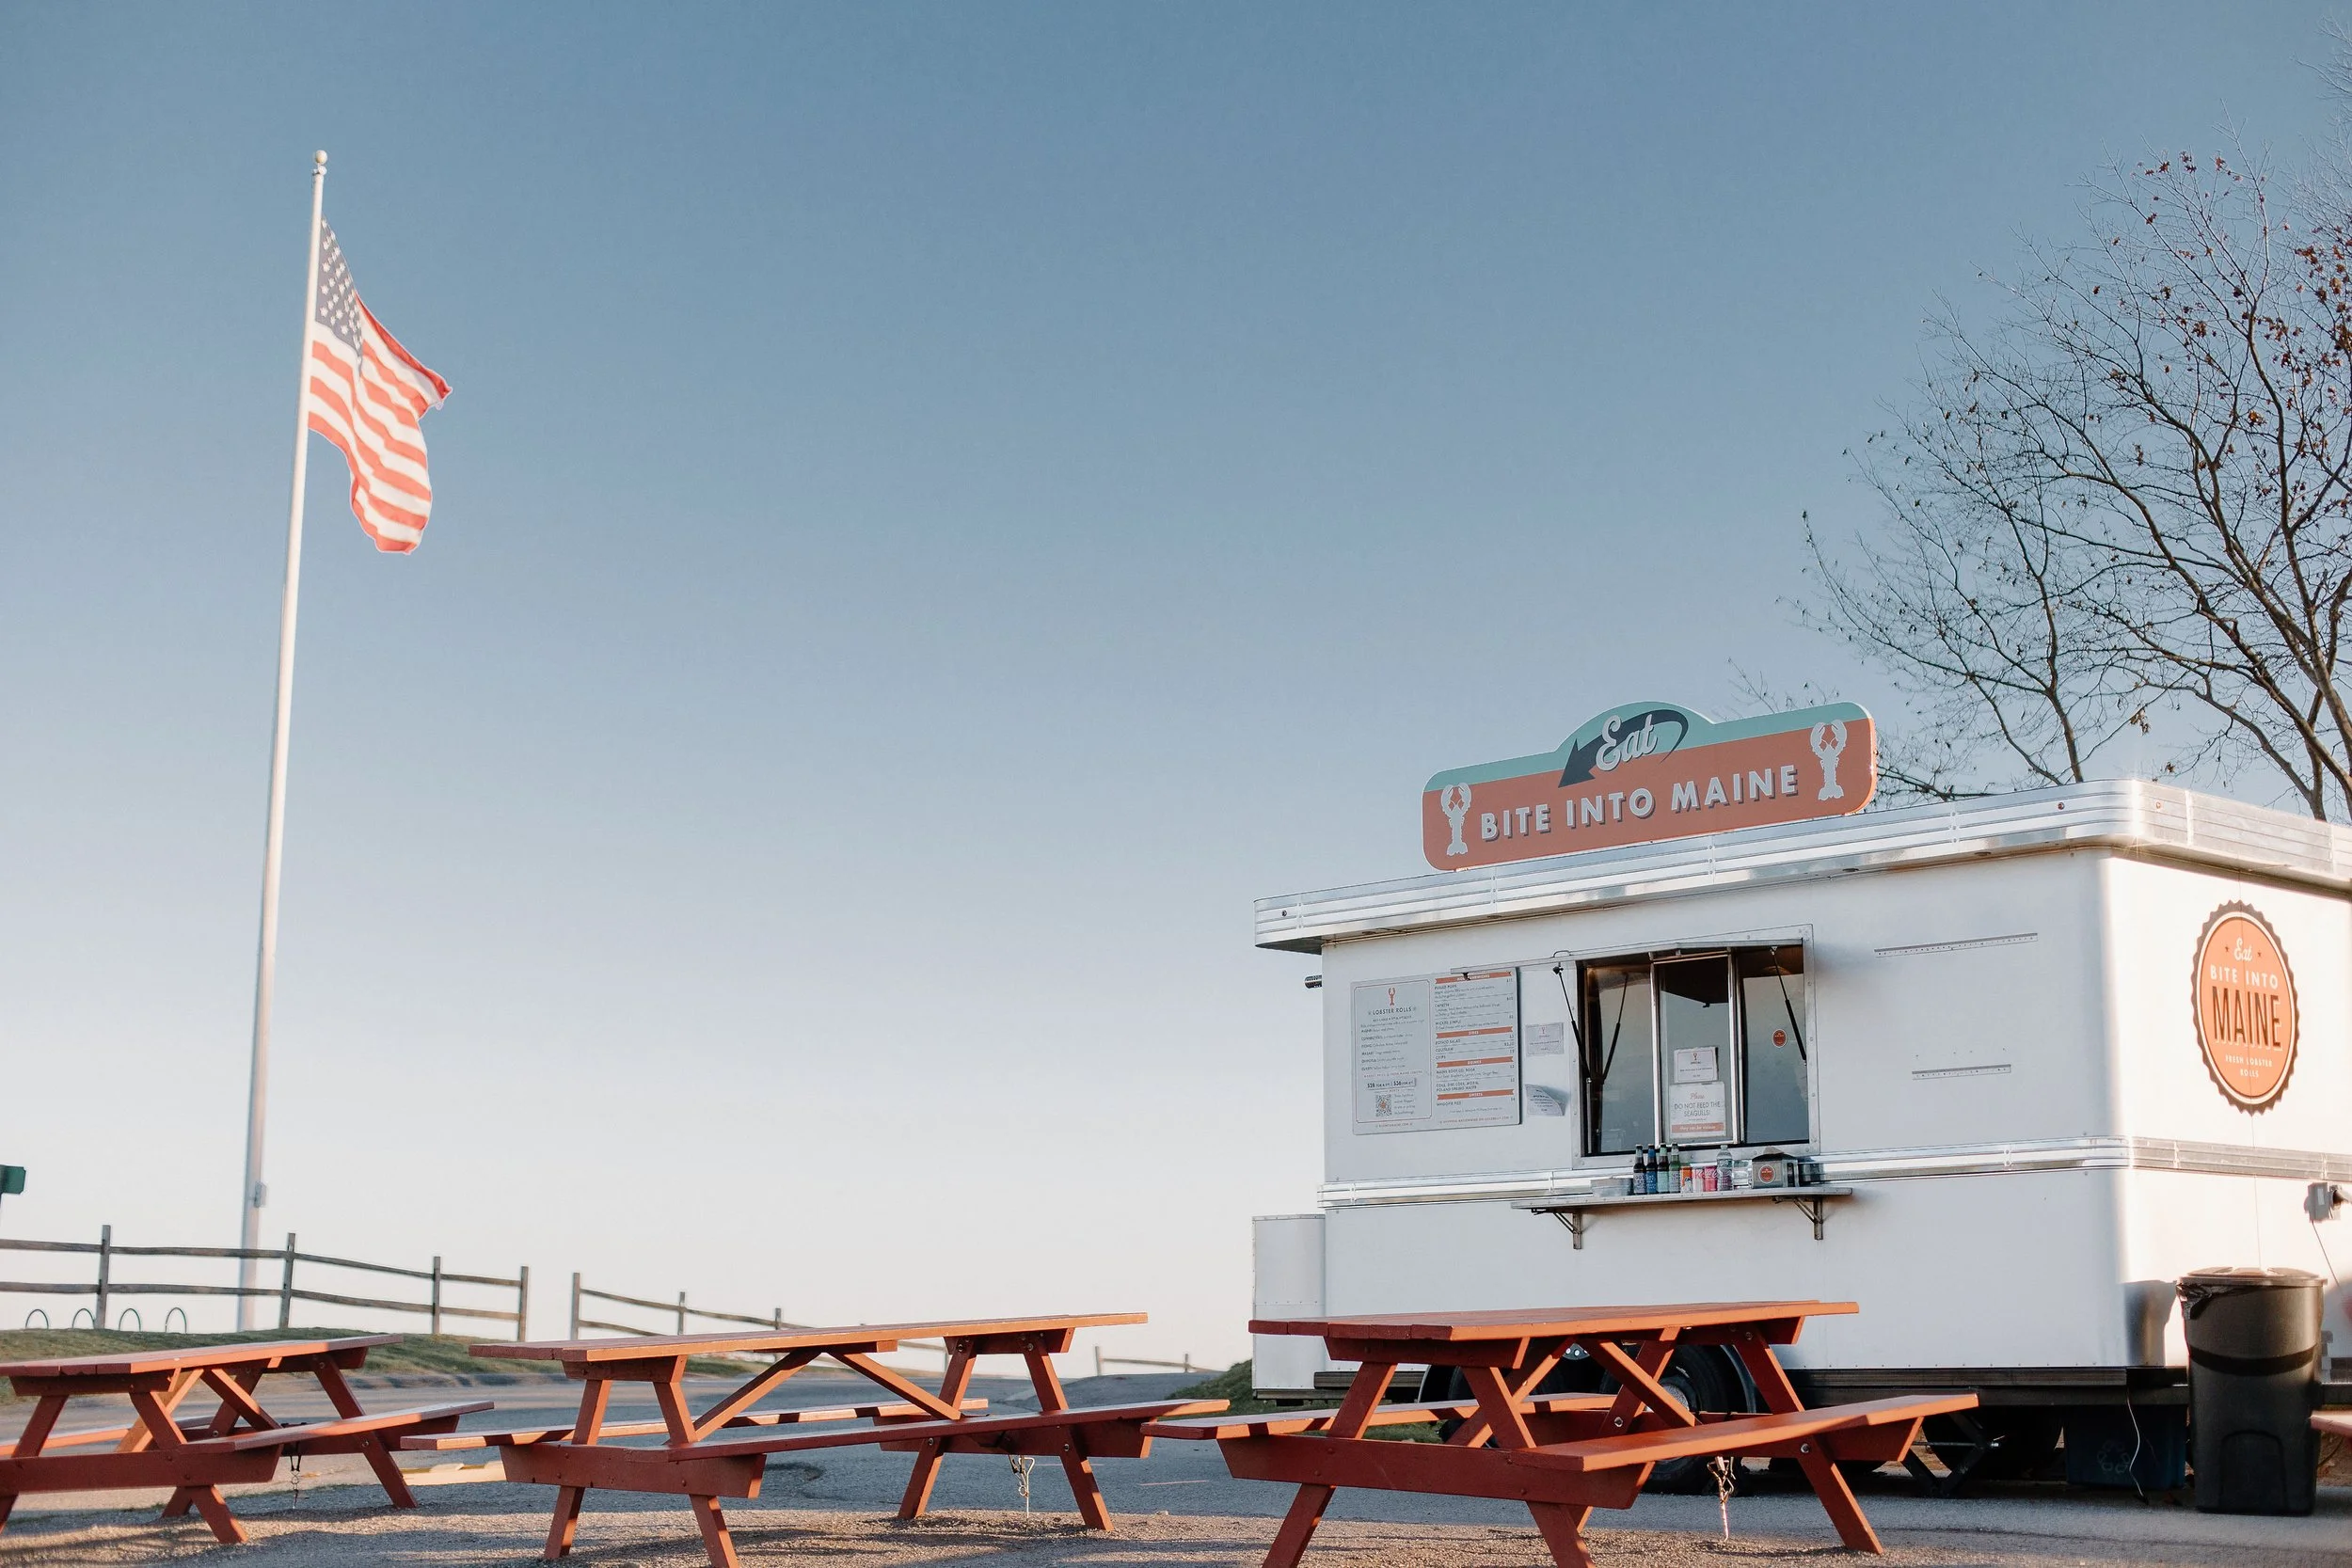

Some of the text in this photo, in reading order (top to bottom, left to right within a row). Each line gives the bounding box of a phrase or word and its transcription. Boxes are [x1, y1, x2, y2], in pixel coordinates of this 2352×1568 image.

[1596, 714, 1659, 771] Eat
[1481, 765, 1801, 842] BITE INTO MAINE
[2210, 964, 2279, 990] BITE INTO
[2233, 937, 2253, 961] Eat
[2212, 985, 2282, 1052] MAINE
